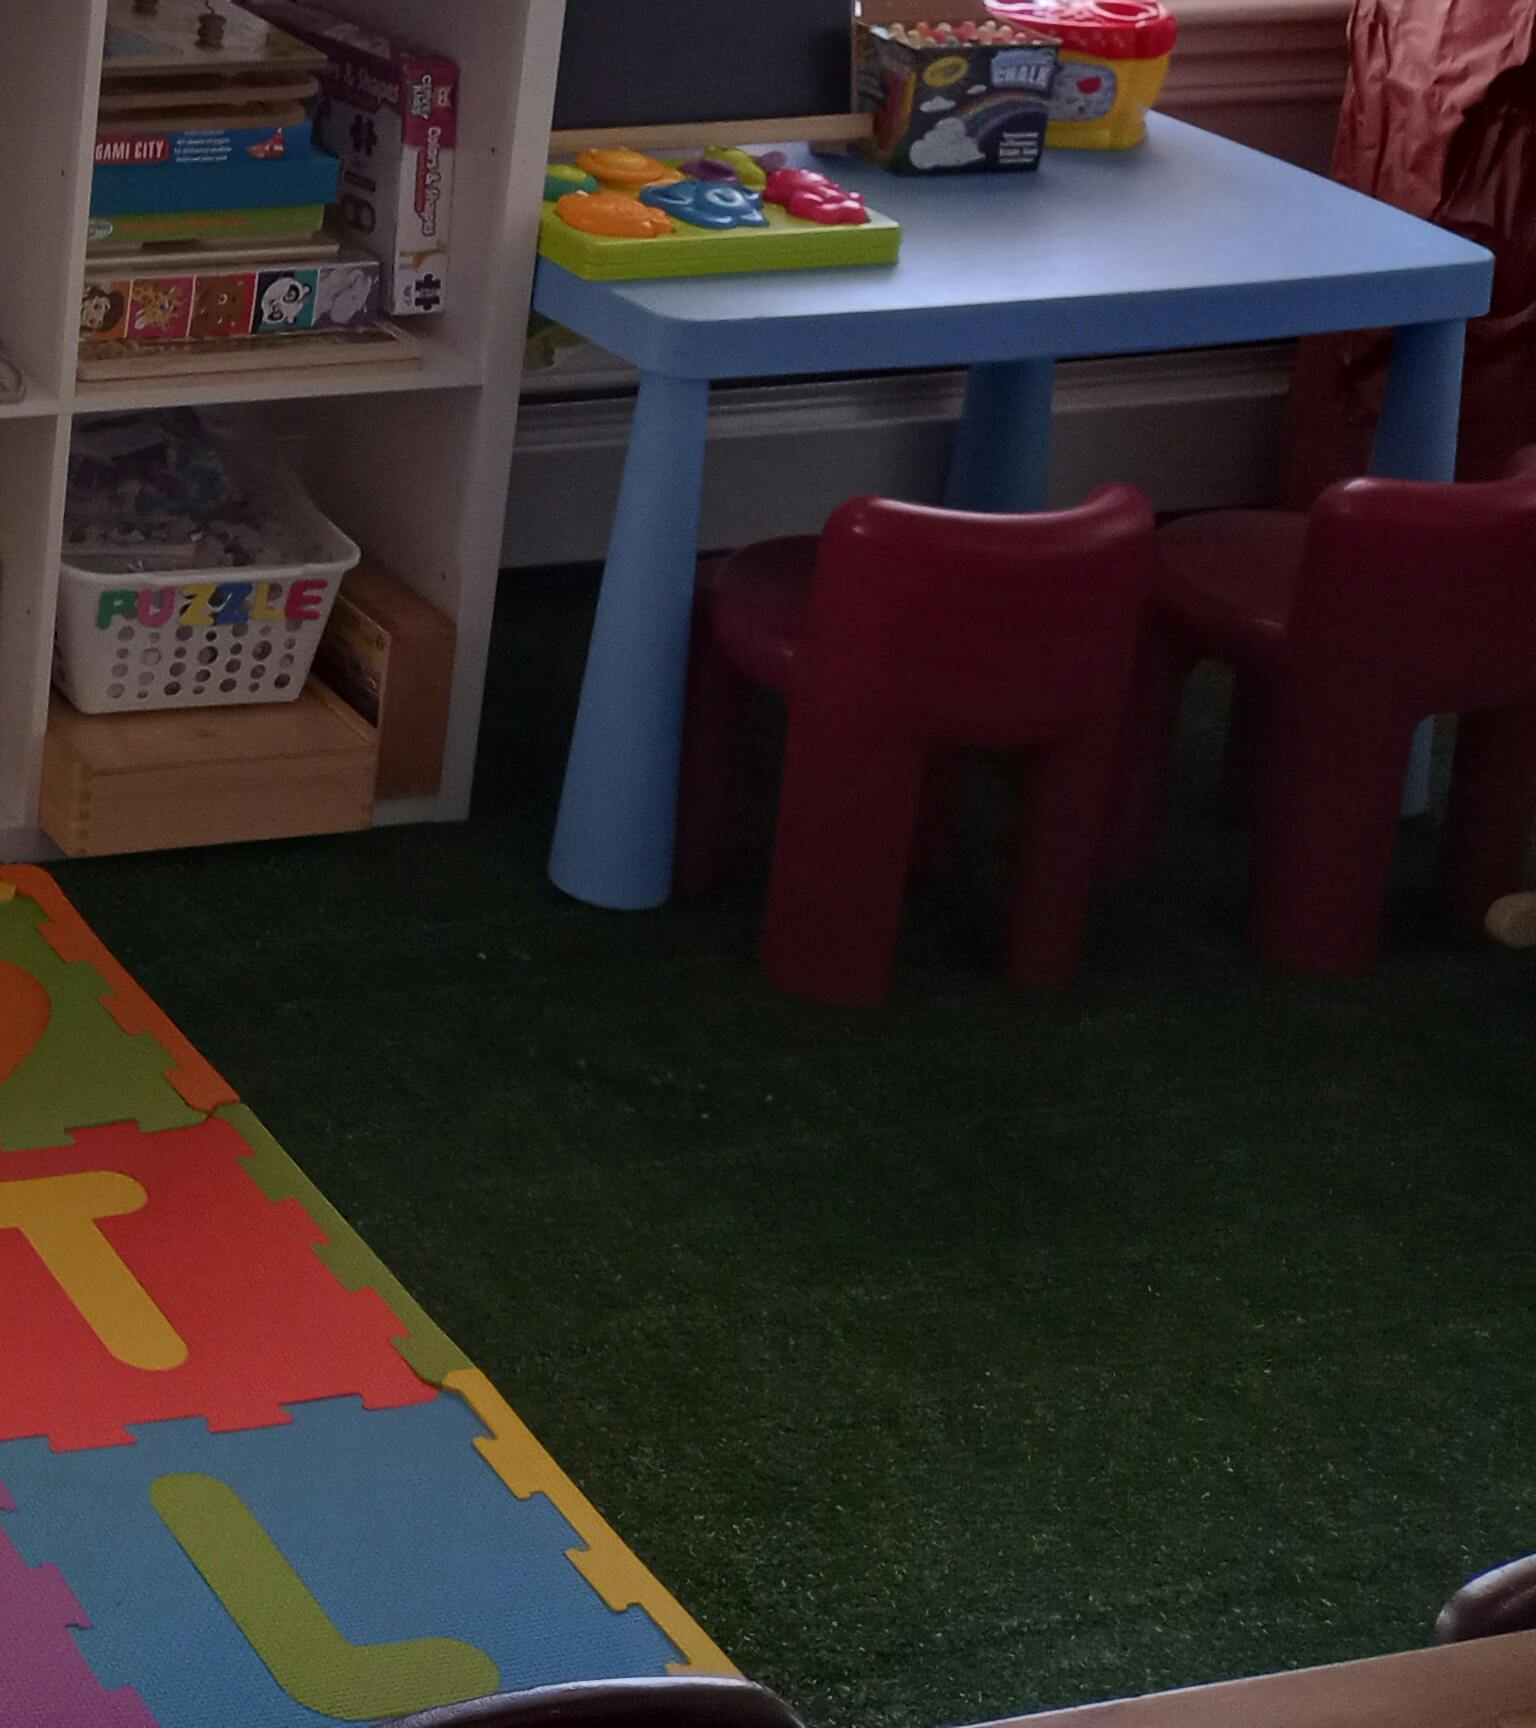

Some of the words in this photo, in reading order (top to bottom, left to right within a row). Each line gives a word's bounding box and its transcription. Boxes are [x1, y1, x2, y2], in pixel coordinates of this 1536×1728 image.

[134, 140, 164, 159] CITY
[95, 579, 328, 630] PUZZLE
[149, 1472, 501, 1721] L
